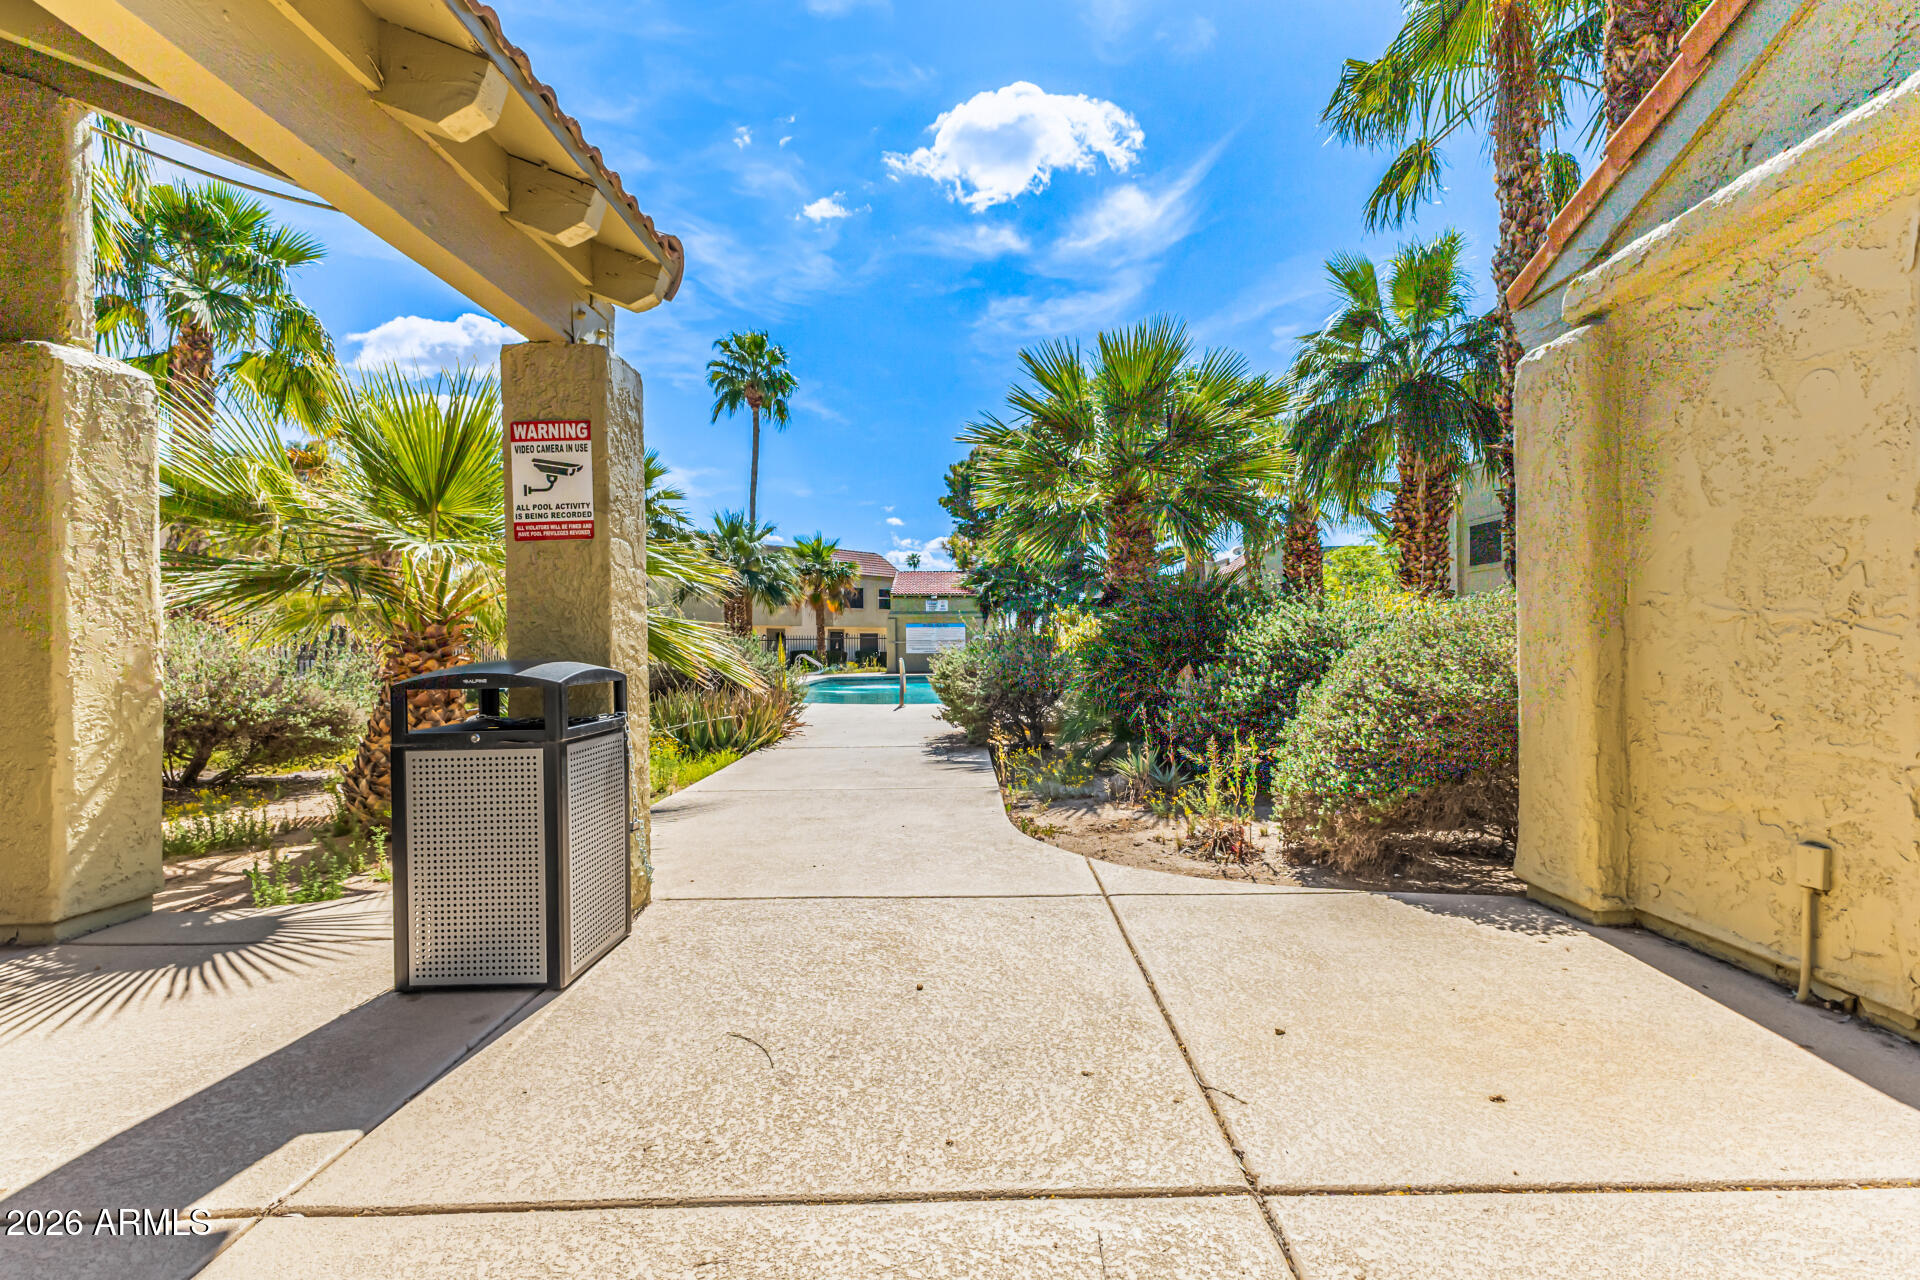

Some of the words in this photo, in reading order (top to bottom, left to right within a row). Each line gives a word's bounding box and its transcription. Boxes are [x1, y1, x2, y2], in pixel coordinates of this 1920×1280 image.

[513, 422, 588, 440] WARNING
[515, 445, 534, 454] VIDEO
[537, 444, 564, 453] CAMERA
[566, 443, 573, 452] IN
[575, 443, 588, 452] USE
[555, 502, 591, 510] ACTIVITY
[525, 512, 548, 520] BEING
[551, 511, 592, 519] RECORDED
